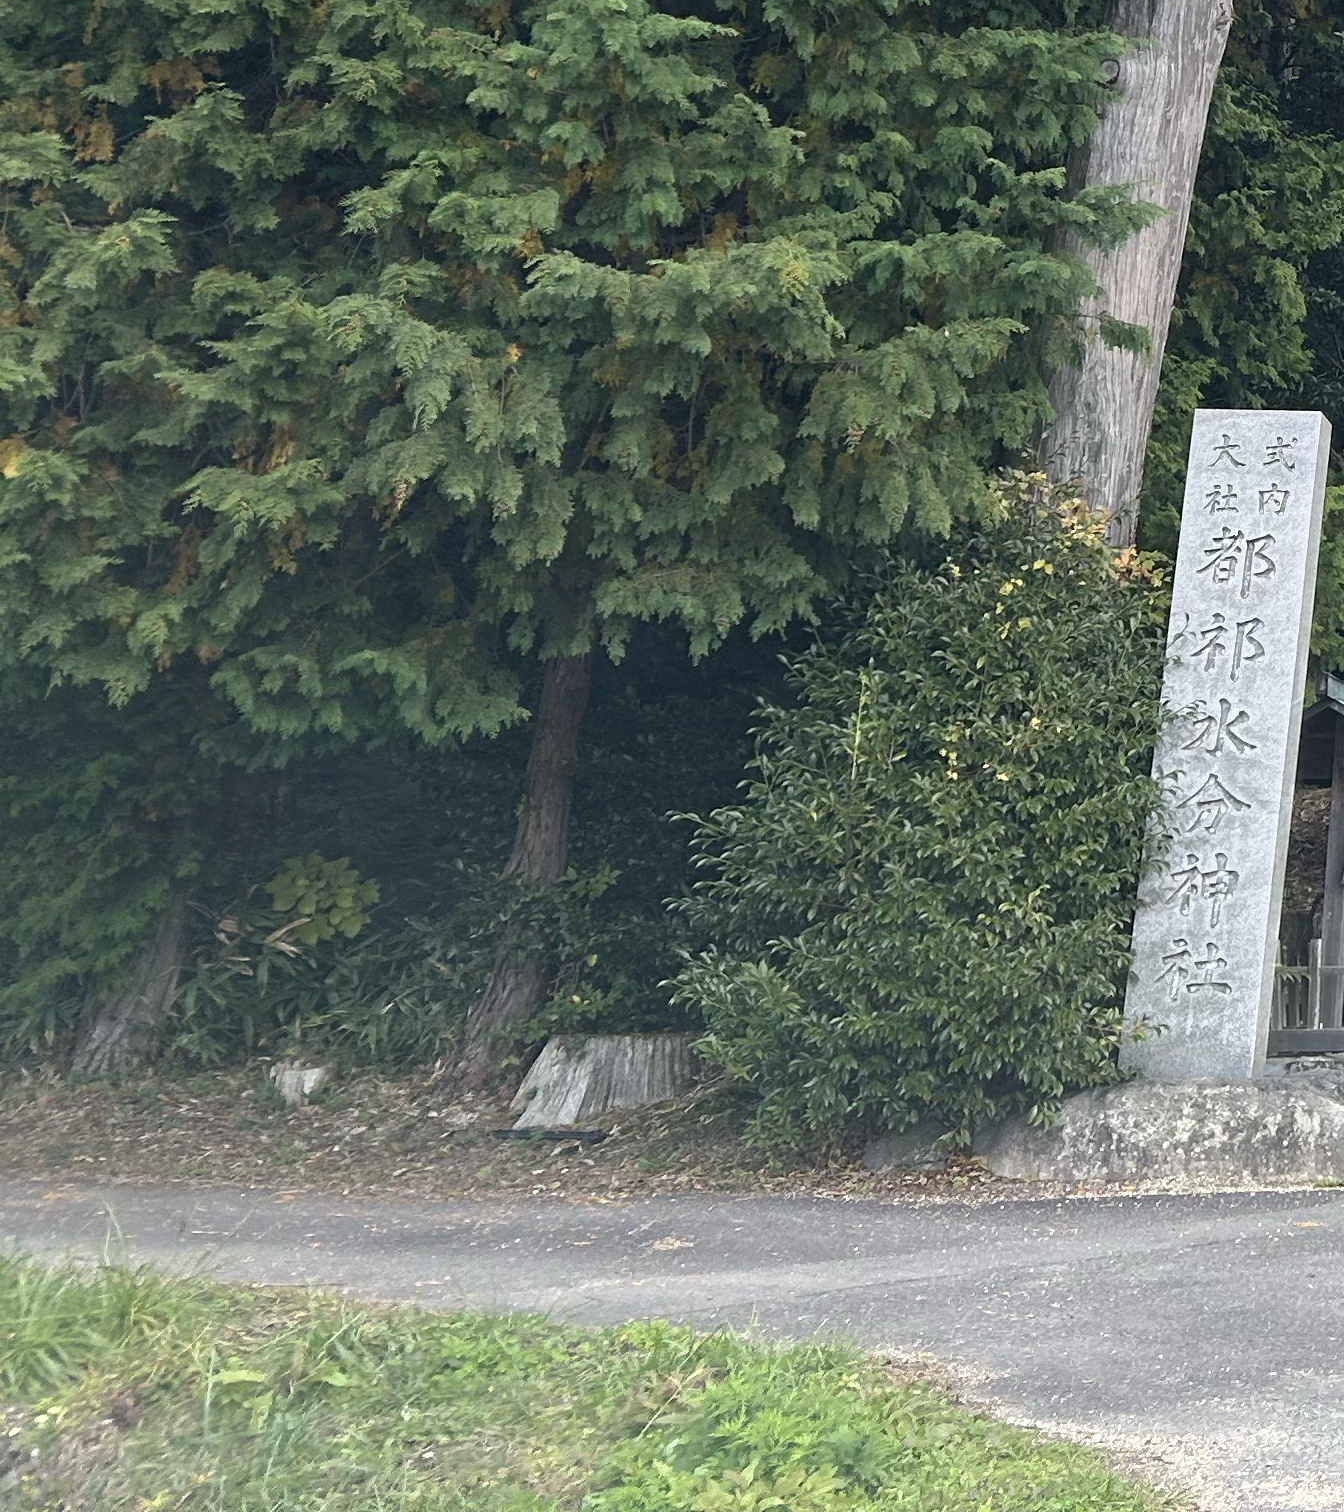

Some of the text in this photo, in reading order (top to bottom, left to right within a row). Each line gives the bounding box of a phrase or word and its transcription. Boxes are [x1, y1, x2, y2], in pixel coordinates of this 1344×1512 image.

[1204, 434, 1246, 516] 大社
[1259, 437, 1298, 515] 式内
[1154, 526, 1277, 1002] 都祁水分神社
